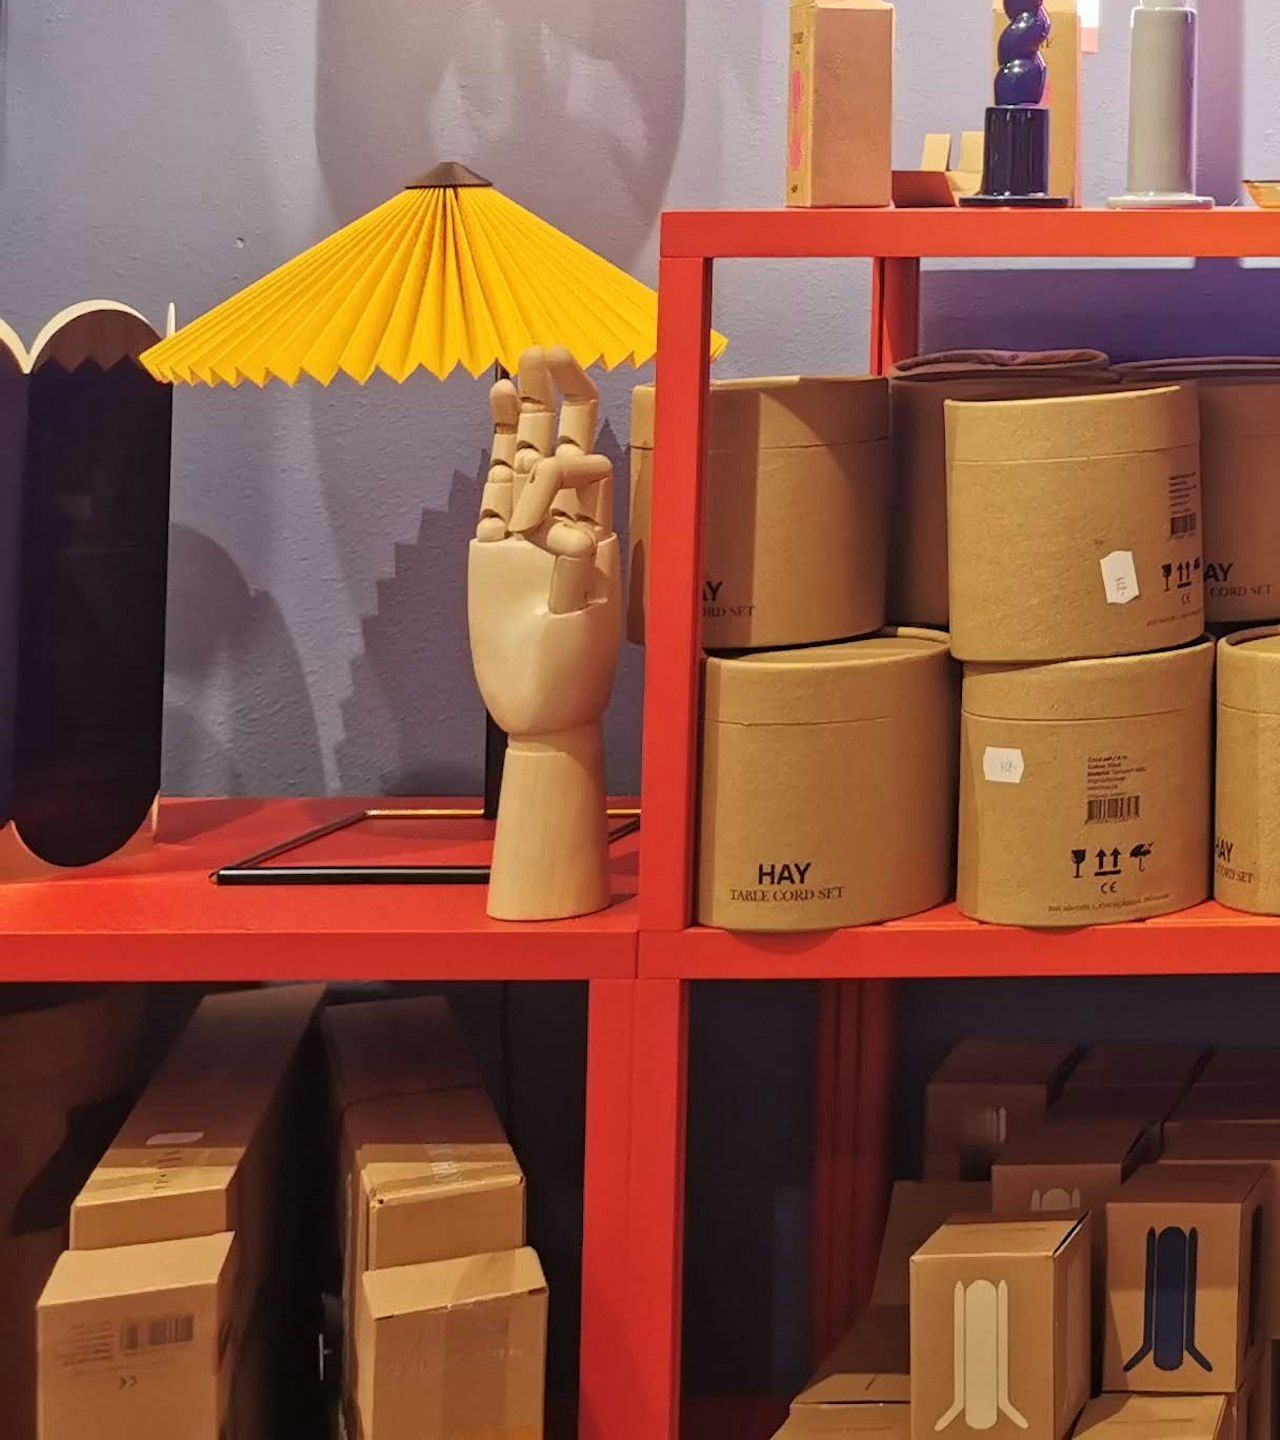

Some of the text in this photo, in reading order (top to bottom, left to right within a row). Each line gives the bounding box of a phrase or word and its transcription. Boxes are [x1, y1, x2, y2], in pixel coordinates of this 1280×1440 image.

[1203, 562, 1234, 583] AY
[758, 861, 812, 885] HAY
[730, 885, 845, 902] TABLE CORD SET
